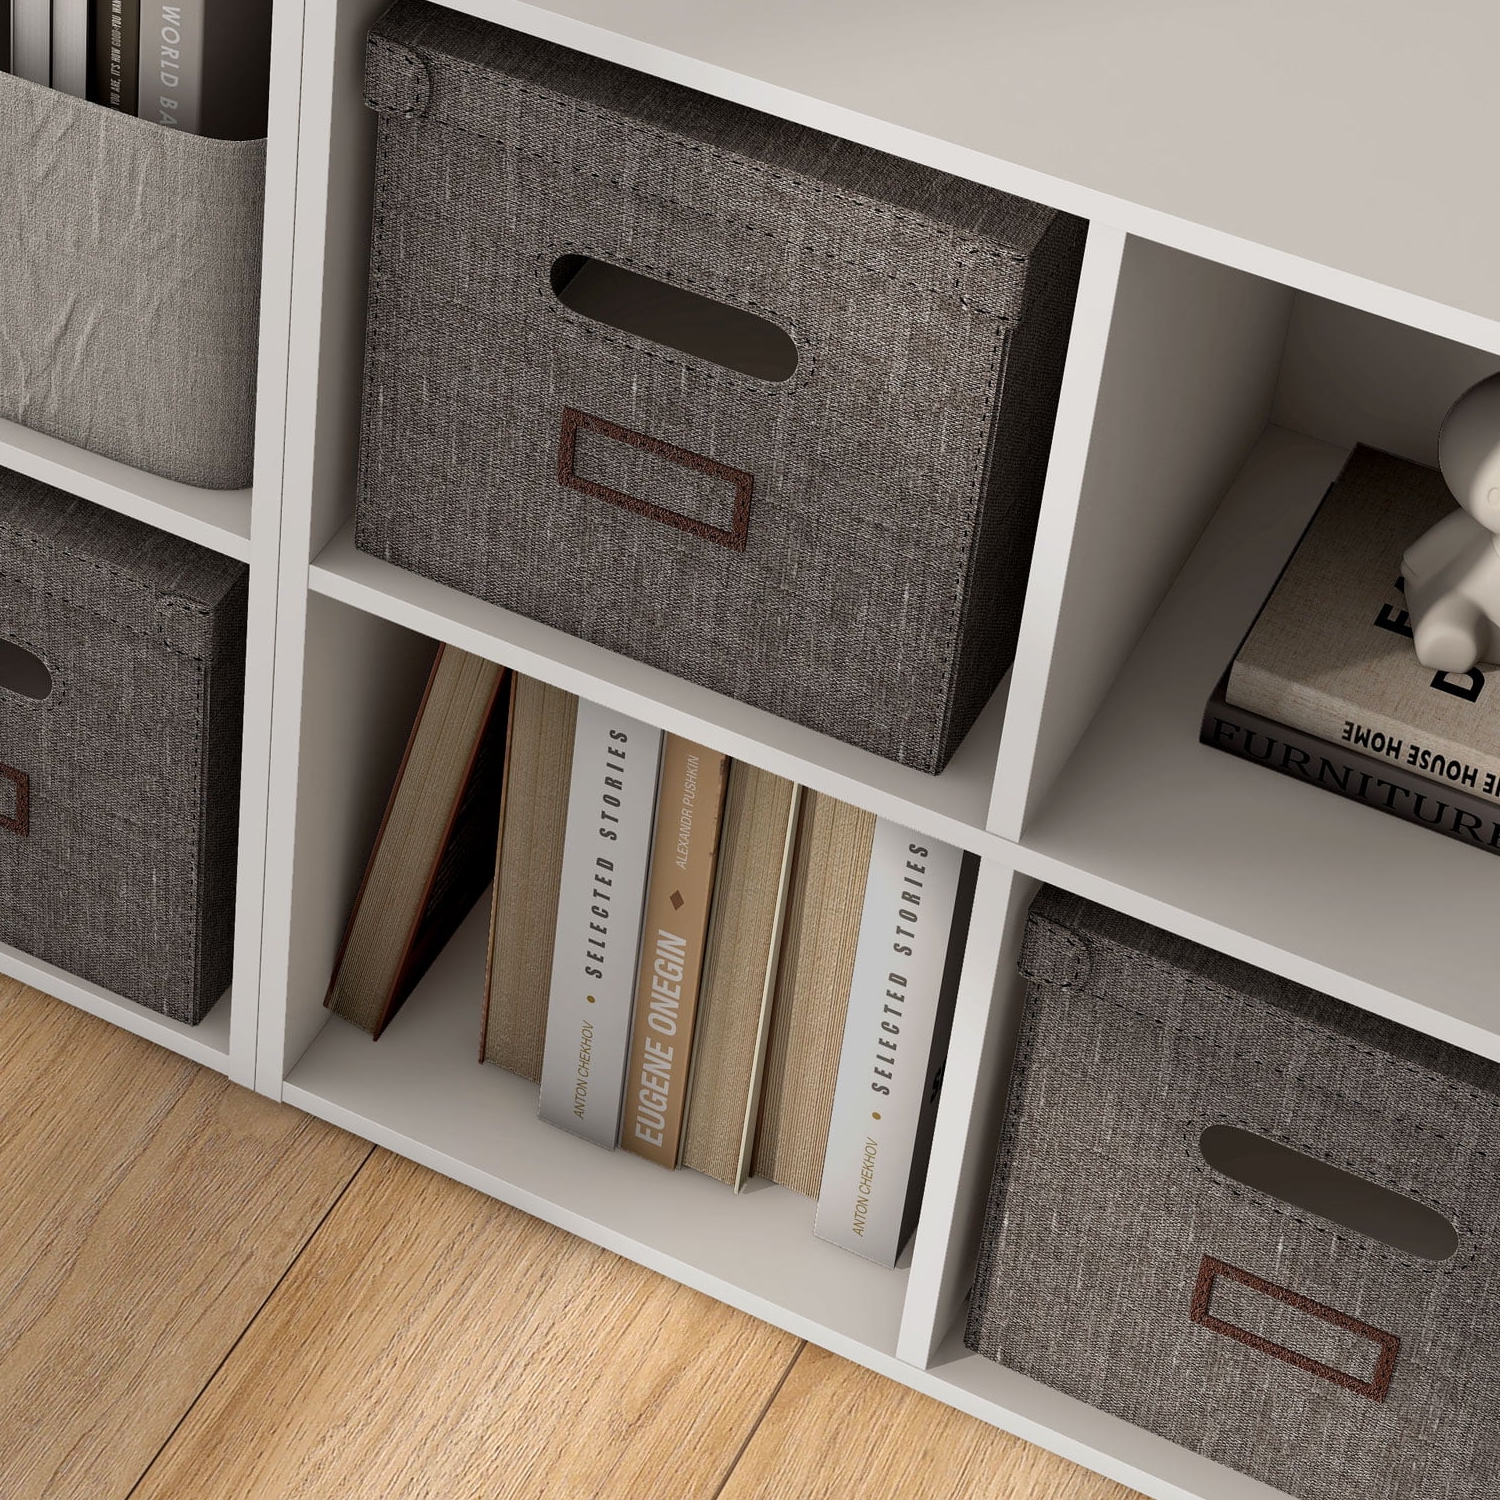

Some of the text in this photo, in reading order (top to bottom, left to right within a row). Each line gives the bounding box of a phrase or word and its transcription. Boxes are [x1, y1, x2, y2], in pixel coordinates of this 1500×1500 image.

[111, 47, 121, 63] HOW
[160, 5, 180, 88] WORLD
[1342, 720, 1402, 760] HOME
[1406, 744, 1478, 788] HOUSE
[585, 730, 628, 979] SELECTED STORIES
[676, 754, 700, 870] ALEXANDR PUSHKIN
[872, 843, 928, 1096] SELECTED STORIES
[574, 1020, 594, 1120] ANTON CHEKHOV
[635, 930, 686, 1148] EUGENE ONEGIN
[852, 1136, 878, 1237] ANTON CHEKHOV
